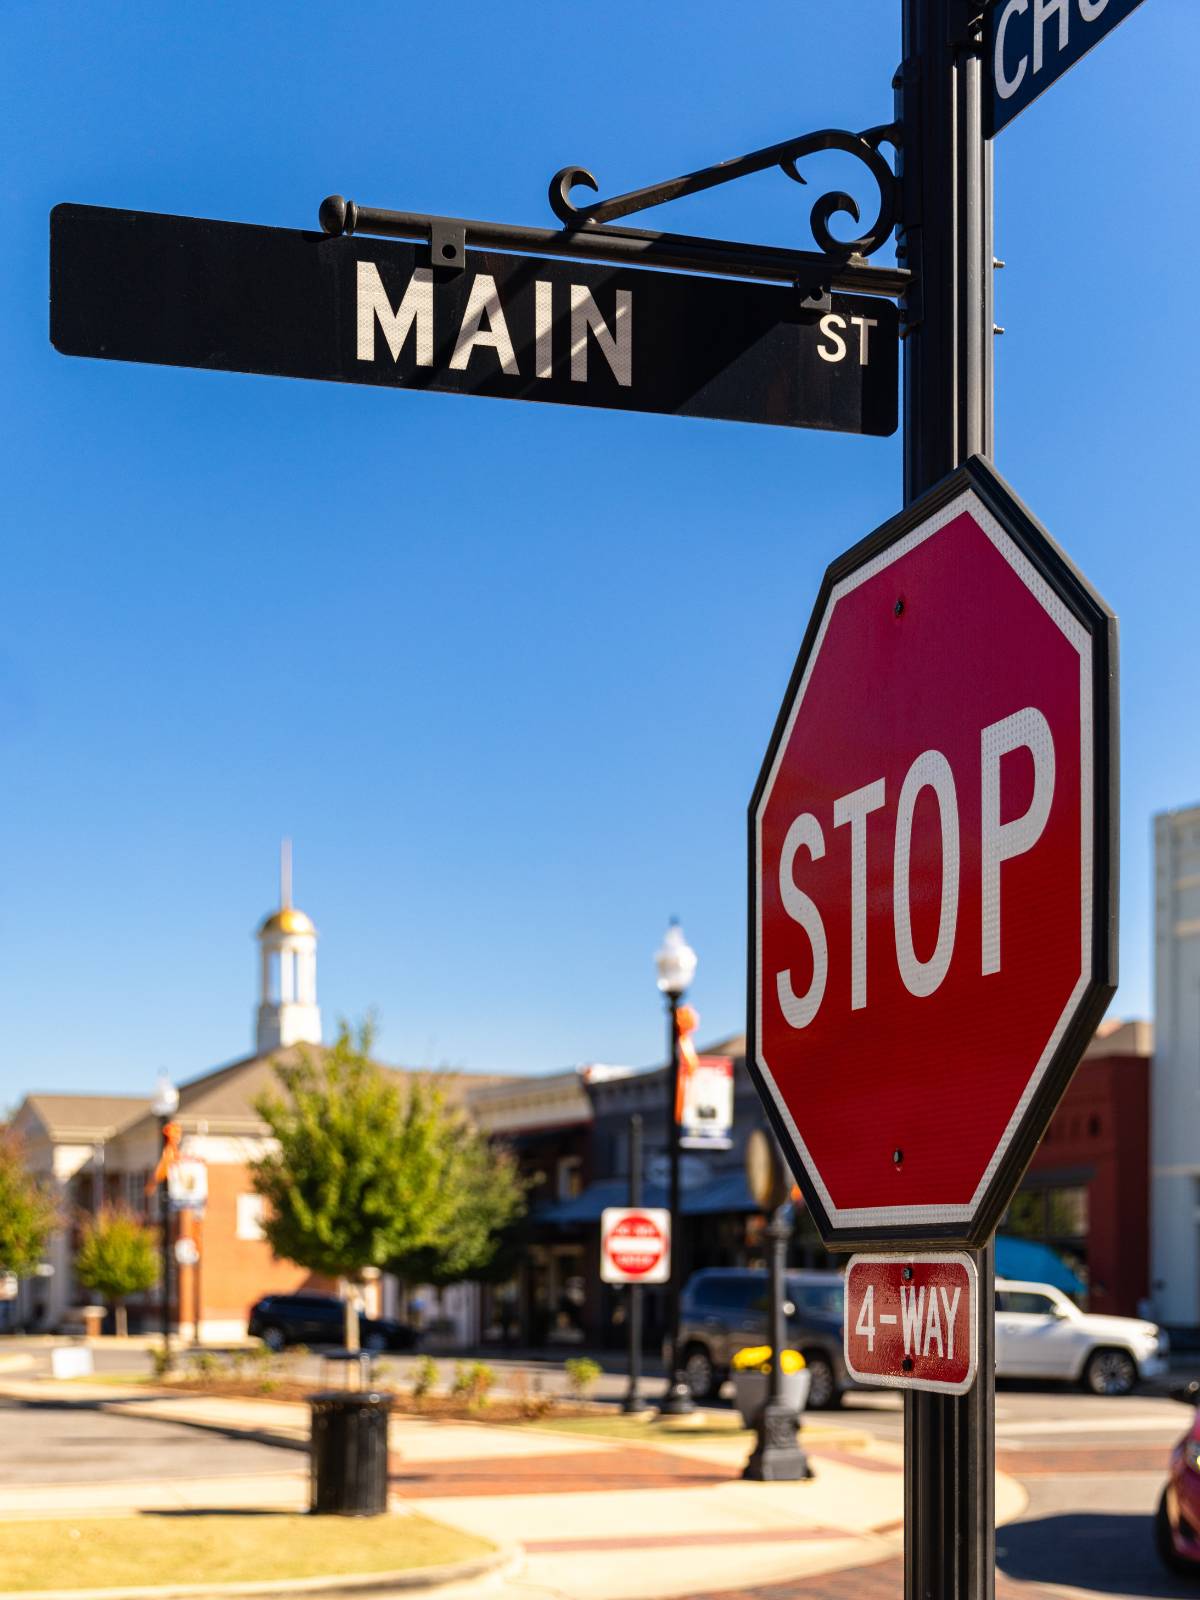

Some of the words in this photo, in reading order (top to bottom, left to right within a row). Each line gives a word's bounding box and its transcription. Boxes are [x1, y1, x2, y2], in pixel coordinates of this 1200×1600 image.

[994, 0, 1108, 99] CH
[356, 260, 633, 387] MAIN
[817, 314, 878, 366] ST
[776, 706, 1056, 1029] STOP
[855, 1285, 961, 1360] 4-WAY
